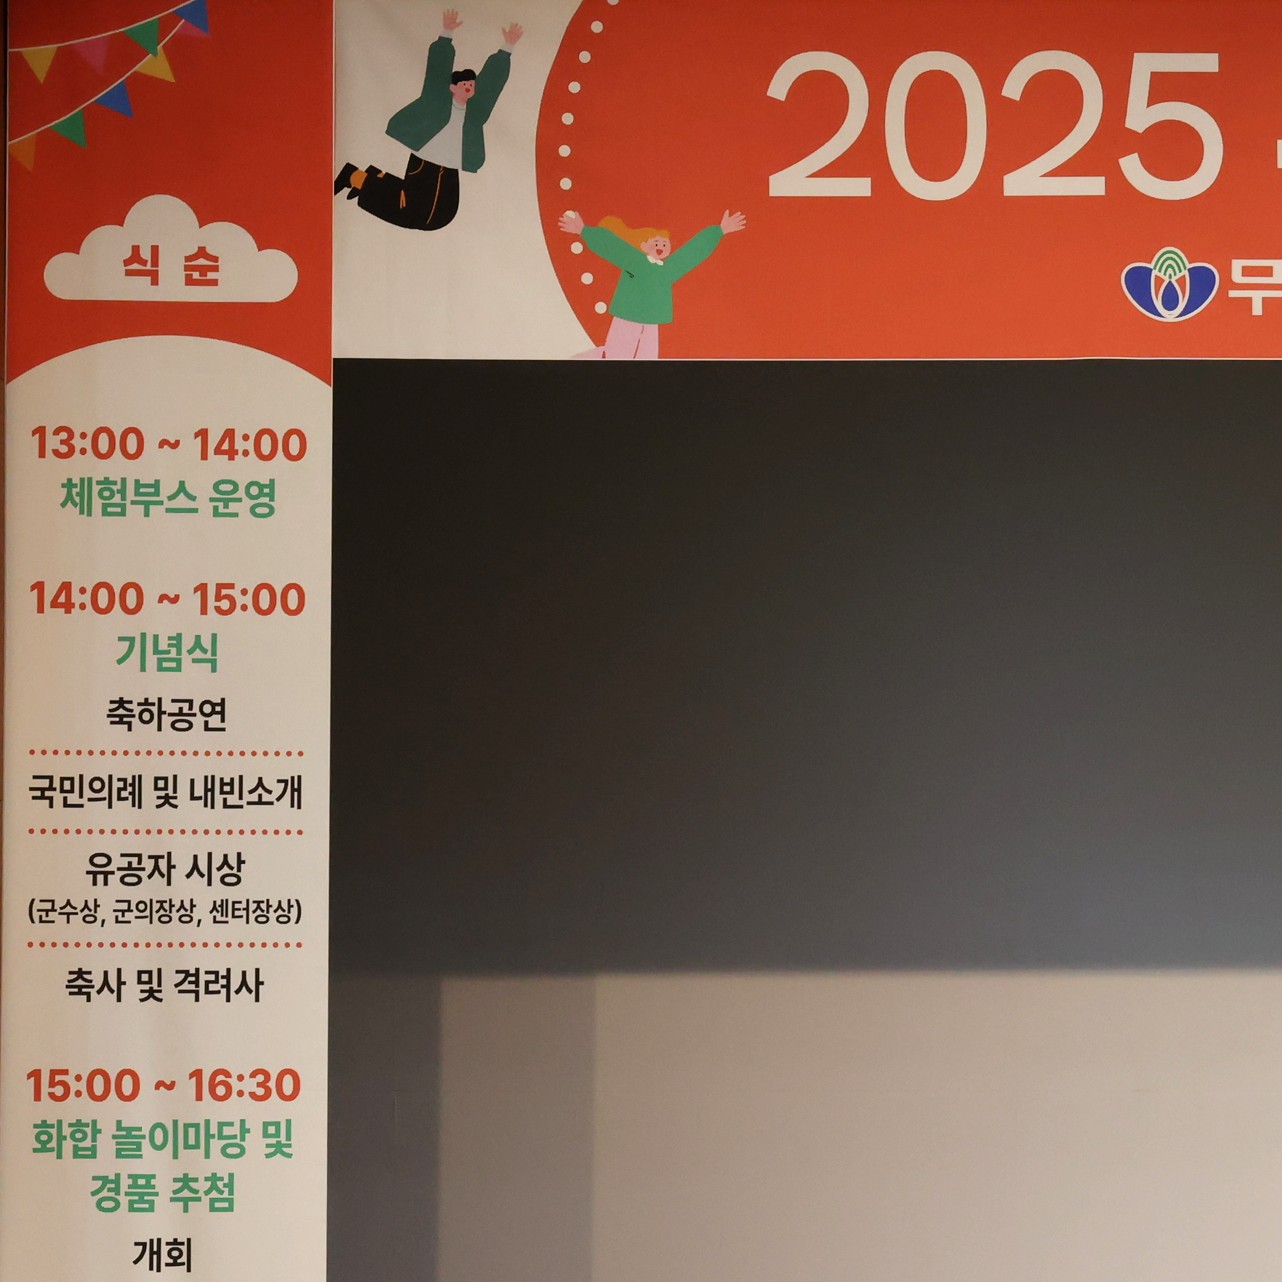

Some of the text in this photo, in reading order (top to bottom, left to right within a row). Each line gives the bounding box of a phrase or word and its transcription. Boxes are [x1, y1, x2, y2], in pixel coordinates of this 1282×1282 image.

[766, 50, 1224, 201] 2025
[31, 425, 308, 462] 13:00 14:00
[59, 476, 276, 519] 체험부스 운영
[29, 580, 306, 617] 14:00 15:00
[115, 631, 218, 674] 기념식
[106, 696, 227, 733] 축하공연
[28, 773, 302, 810] 국민의례 및 내빈소개
[85, 851, 246, 887] 유공자 시상
[28, 897, 302, 928] (군수상, 군의장상, 센터장상)
[65, 967, 265, 1003] 축사 및 격려사
[26, 1067, 301, 1103] 15:00 16:30
[31, 1118, 294, 1160] 화합 놀이마당 및
[90, 1172, 235, 1214] 경품 추첨
[132, 1237, 192, 1273] 개회
